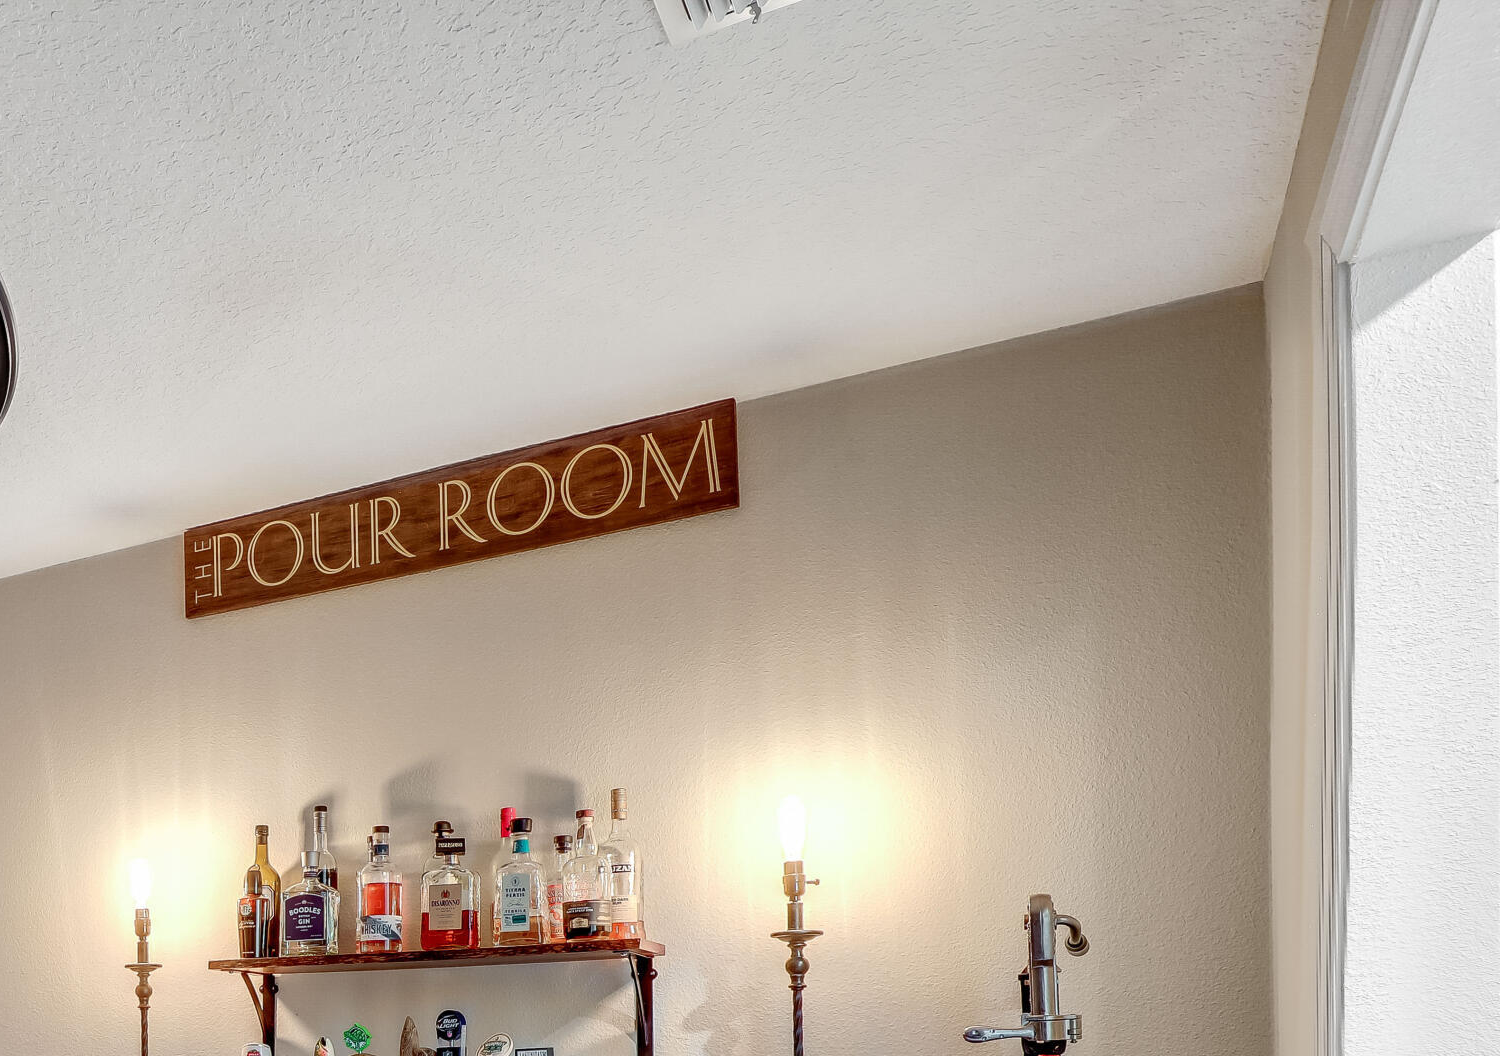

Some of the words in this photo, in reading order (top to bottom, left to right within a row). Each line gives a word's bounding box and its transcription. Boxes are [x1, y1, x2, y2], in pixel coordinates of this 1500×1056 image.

[209, 495, 417, 598] POUR
[437, 418, 721, 551] ROOM
[194, 537, 212, 604] THE
[288, 906, 322, 917] BOODLES
[431, 899, 461, 907] DISARONNO
